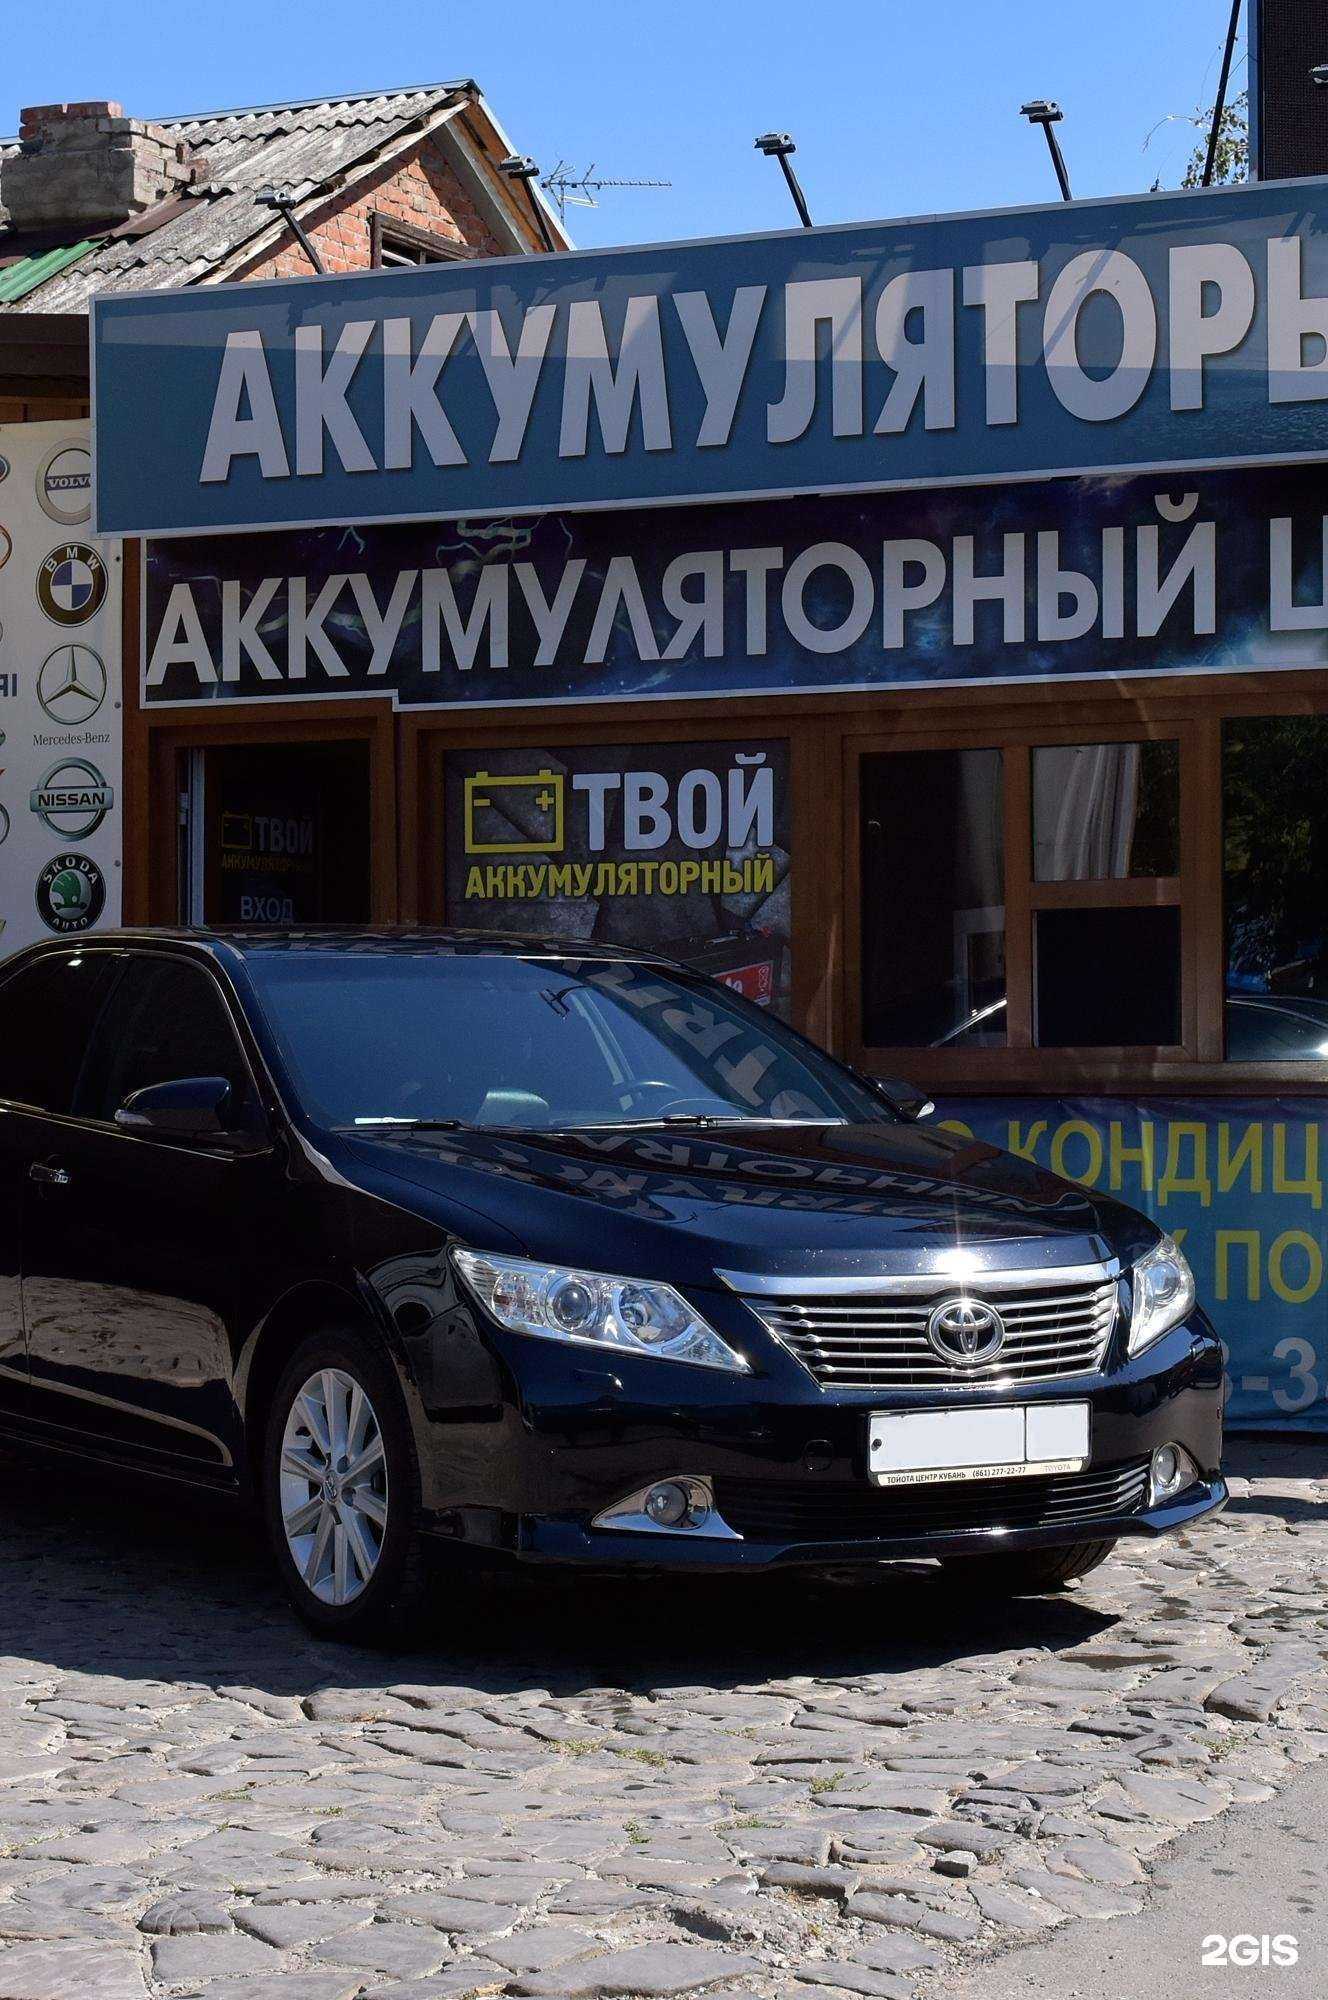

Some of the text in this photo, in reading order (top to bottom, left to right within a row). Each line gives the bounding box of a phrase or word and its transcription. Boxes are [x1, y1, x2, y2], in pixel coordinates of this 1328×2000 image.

[48, 477, 91, 488] VOLV
[44, 546, 100, 573] BMW
[146, 492, 1216, 685] АККУМУЛЯТОРНЫЙ
[33, 732, 111, 746] Mercedes-Benz
[38, 792, 105, 807] NISSAN
[572, 752, 774, 851] ТВОЙ
[465, 853, 774, 899] АККУМУЛЯТОРНЫЙ
[240, 895, 296, 926] ВХОД
[887, 1475, 914, 1484] ТОЙОТА
[915, 1473, 937, 1483] ЦЕНТР
[938, 1471, 966, 1480] КУБАНЬ
[972, 1469, 990, 1478] (861)
[1044, 1463, 1071, 1473] TOYOTA
